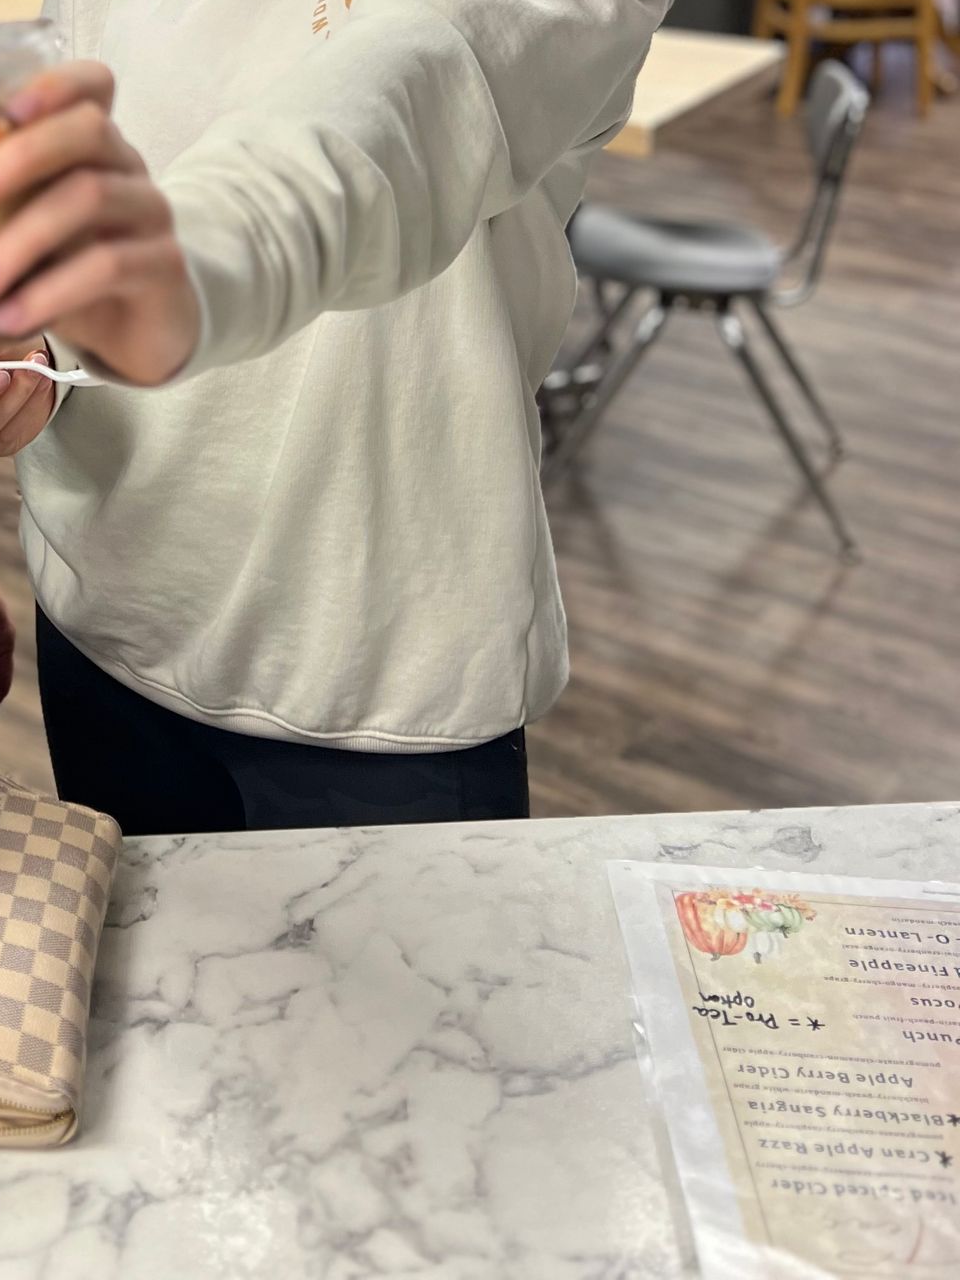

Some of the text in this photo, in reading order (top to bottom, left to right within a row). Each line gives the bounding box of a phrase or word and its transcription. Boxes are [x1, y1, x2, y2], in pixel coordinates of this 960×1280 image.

[844, 927, 922, 943] Lantern
[910, 997, 960, 1010] ocus
[737, 1064, 913, 1089] Apple Berry Cider
[747, 1100, 827, 1117] Sangria
[758, 1139, 931, 1163] Cran Apple Razz
[770, 1179, 827, 1196] Cider
[911, 1188, 957, 1204] Iced
